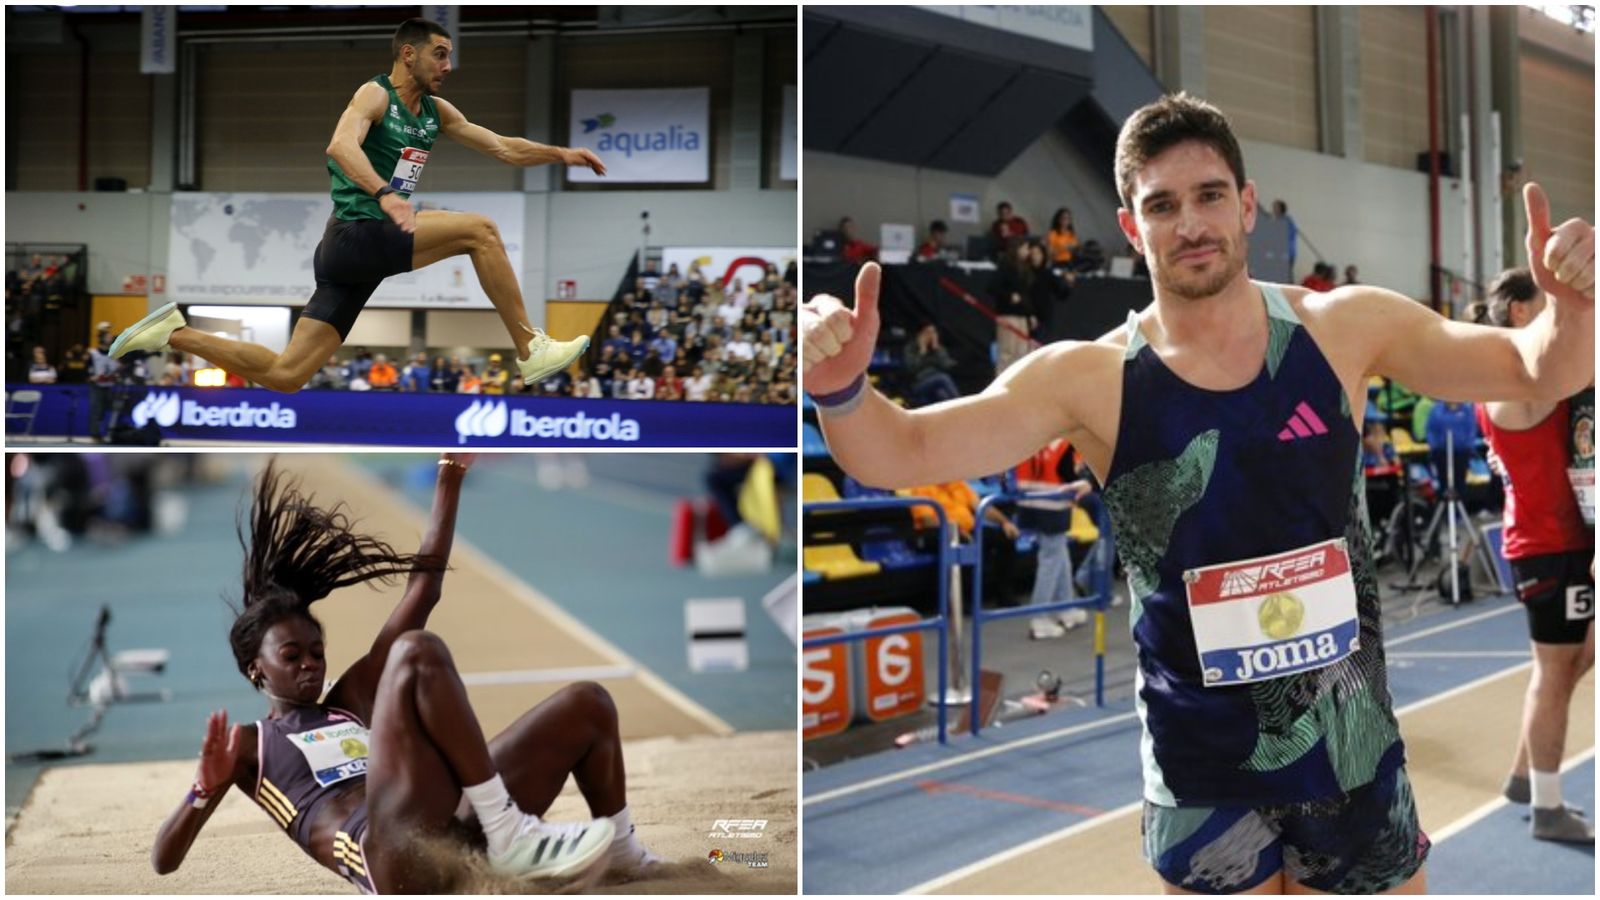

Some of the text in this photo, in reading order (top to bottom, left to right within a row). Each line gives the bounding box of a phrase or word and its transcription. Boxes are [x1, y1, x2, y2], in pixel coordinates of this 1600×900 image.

[597, 124, 700, 158] aqualia
[181, 400, 297, 428] Iberdrola
[510, 409, 640, 441] Iberdrola
[1261, 551, 1326, 580] RFEA
[803, 634, 911, 704] 5 6
